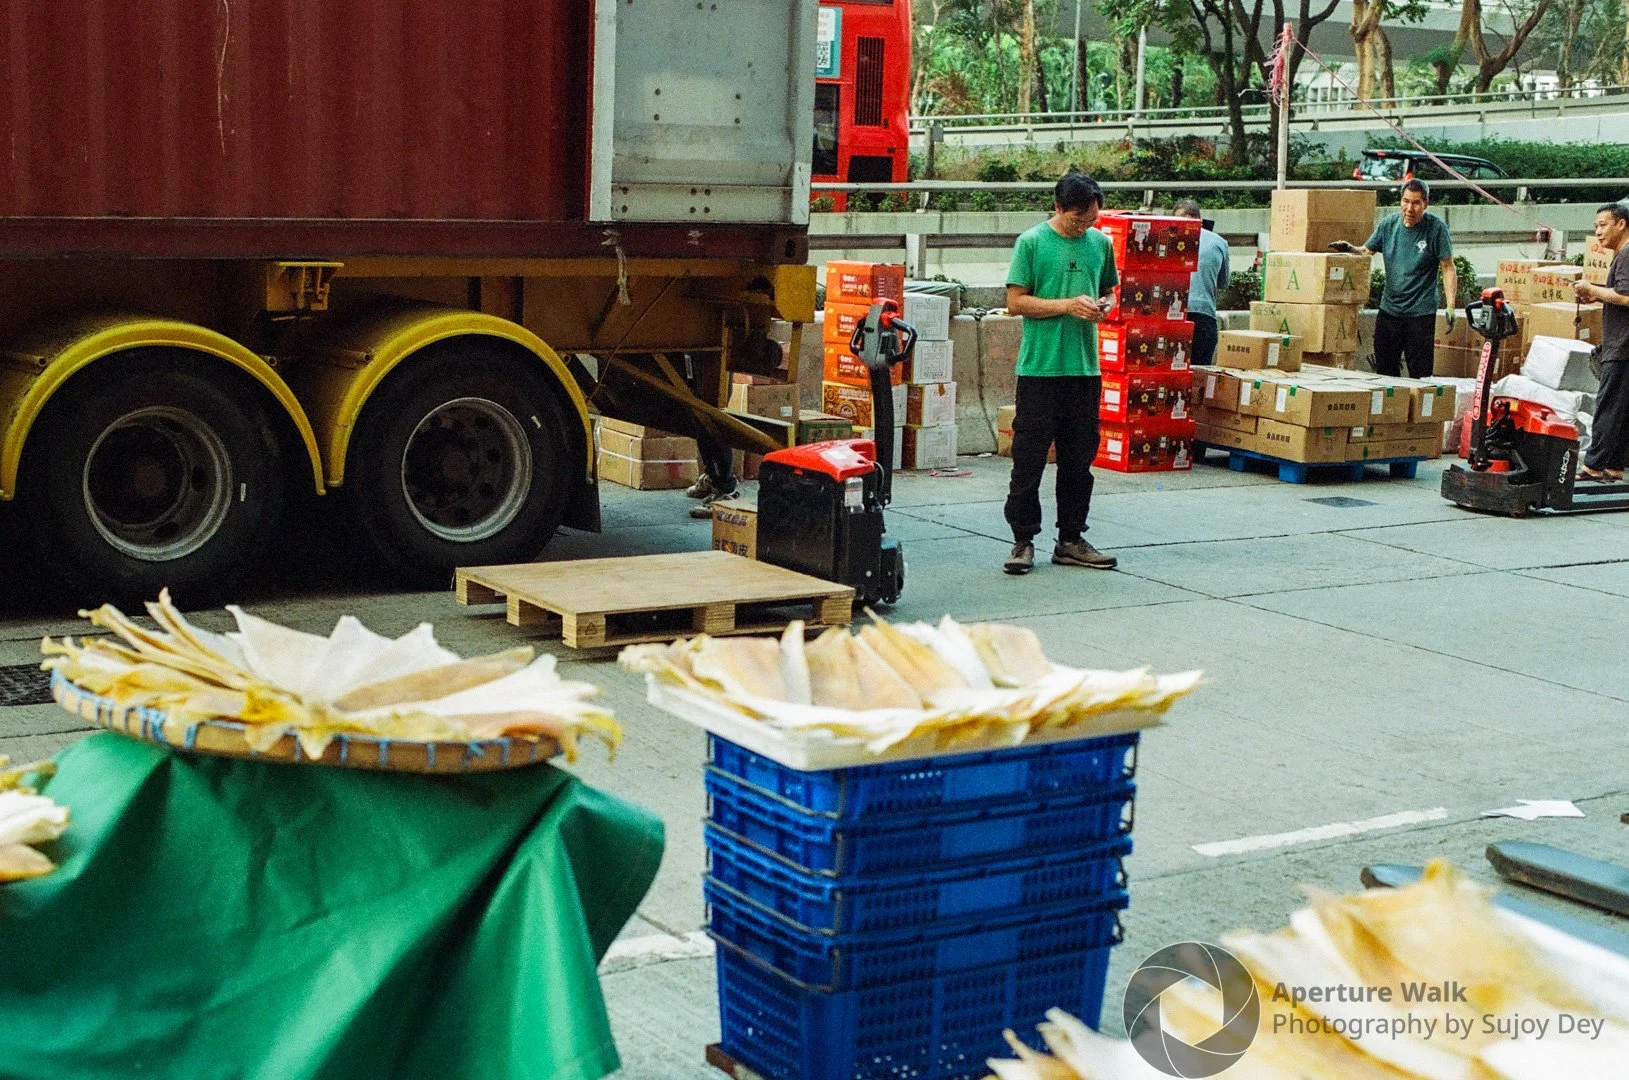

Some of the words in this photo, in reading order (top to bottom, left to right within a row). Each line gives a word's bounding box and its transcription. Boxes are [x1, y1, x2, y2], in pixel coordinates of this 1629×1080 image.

[1287, 268, 1300, 291] A
[1340, 271, 1356, 291] A
[1278, 317, 1291, 335] A
[1335, 321, 1347, 340] A
